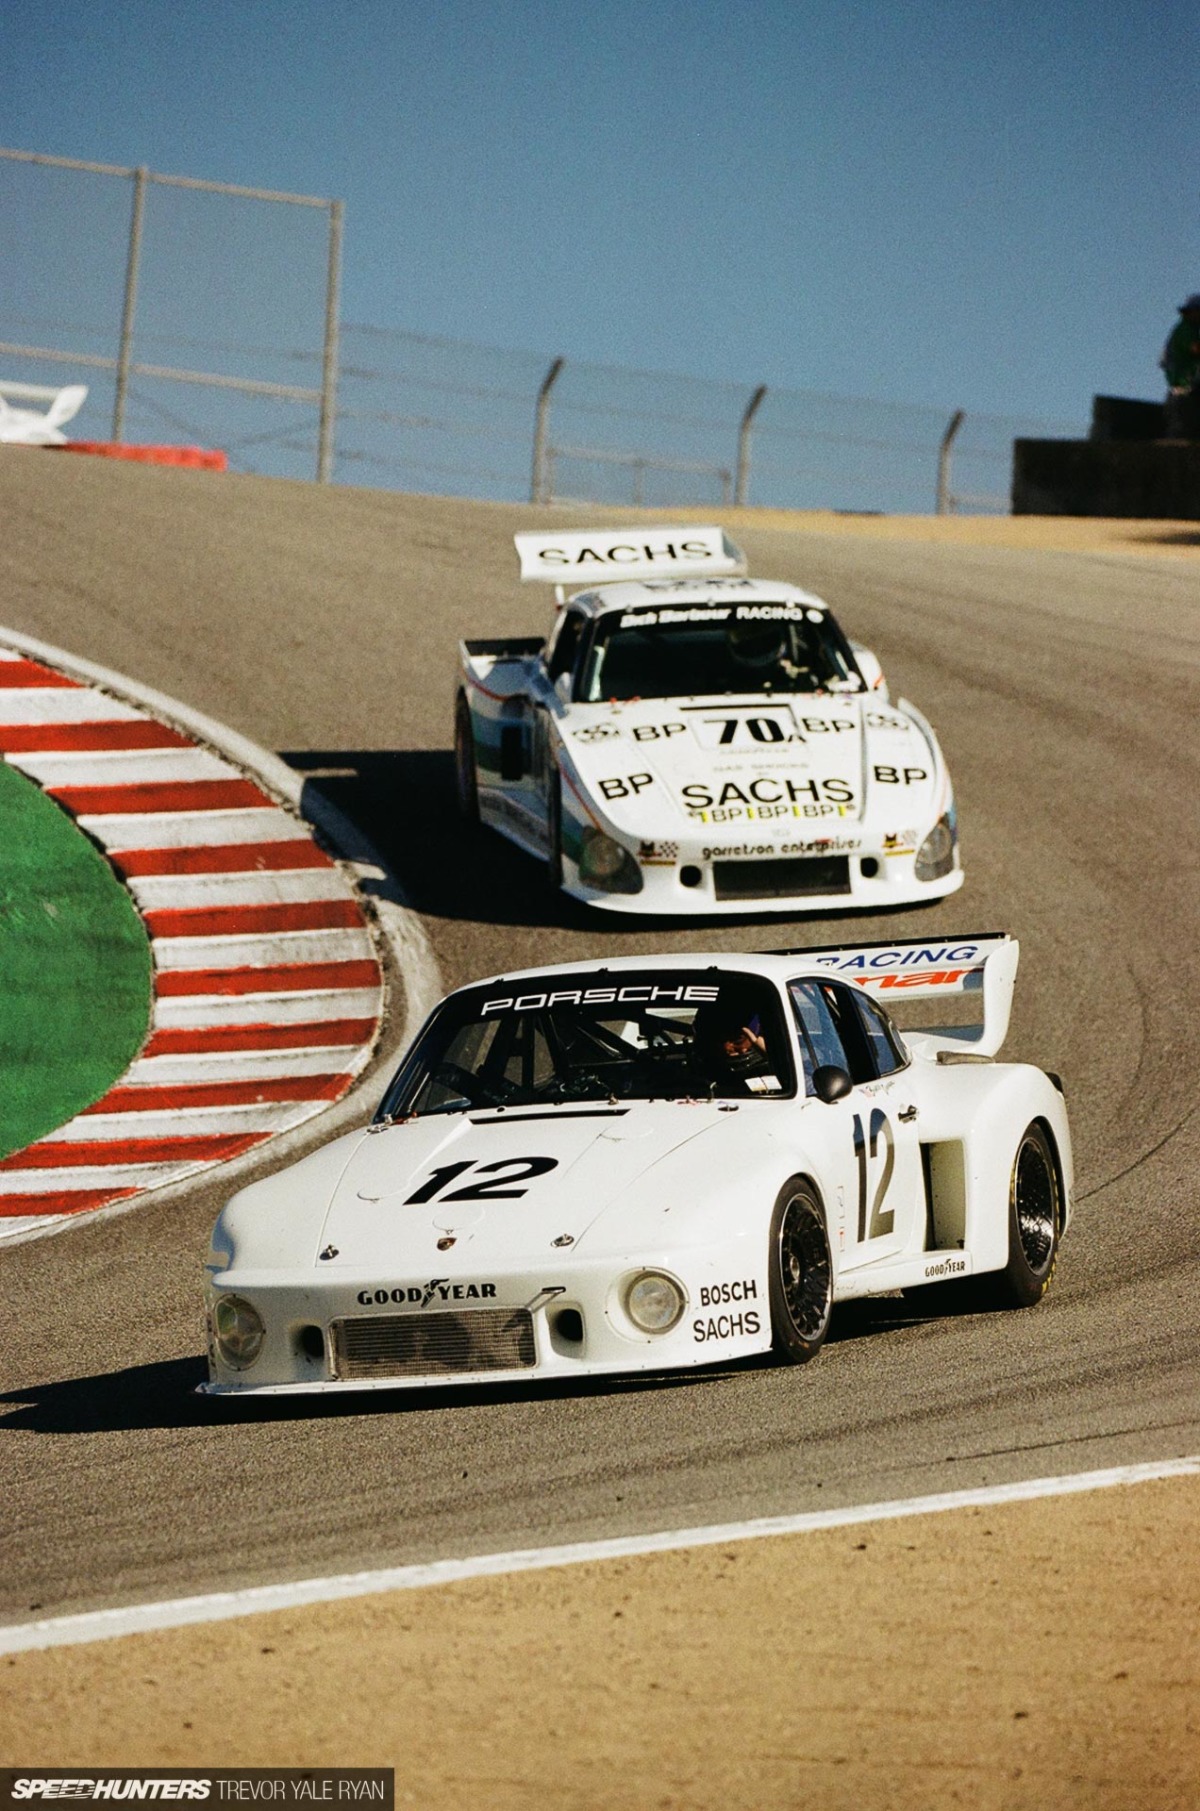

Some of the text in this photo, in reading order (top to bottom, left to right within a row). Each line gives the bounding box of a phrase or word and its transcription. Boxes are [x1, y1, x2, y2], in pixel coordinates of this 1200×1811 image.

[539, 541, 712, 564] SACHS
[736, 606, 803, 621] RACING
[633, 723, 687, 742] BP
[801, 717, 855, 733] BP
[598, 772, 654, 800] BP
[873, 765, 928, 785] BP
[681, 778, 854, 809] SACHS
[480, 986, 720, 1016] PORSCHE
[402, 1156, 559, 1206] 12
[853, 1107, 895, 1243] 12
[700, 1279, 757, 1307] BOSCH
[693, 1311, 761, 1343] SACHS
